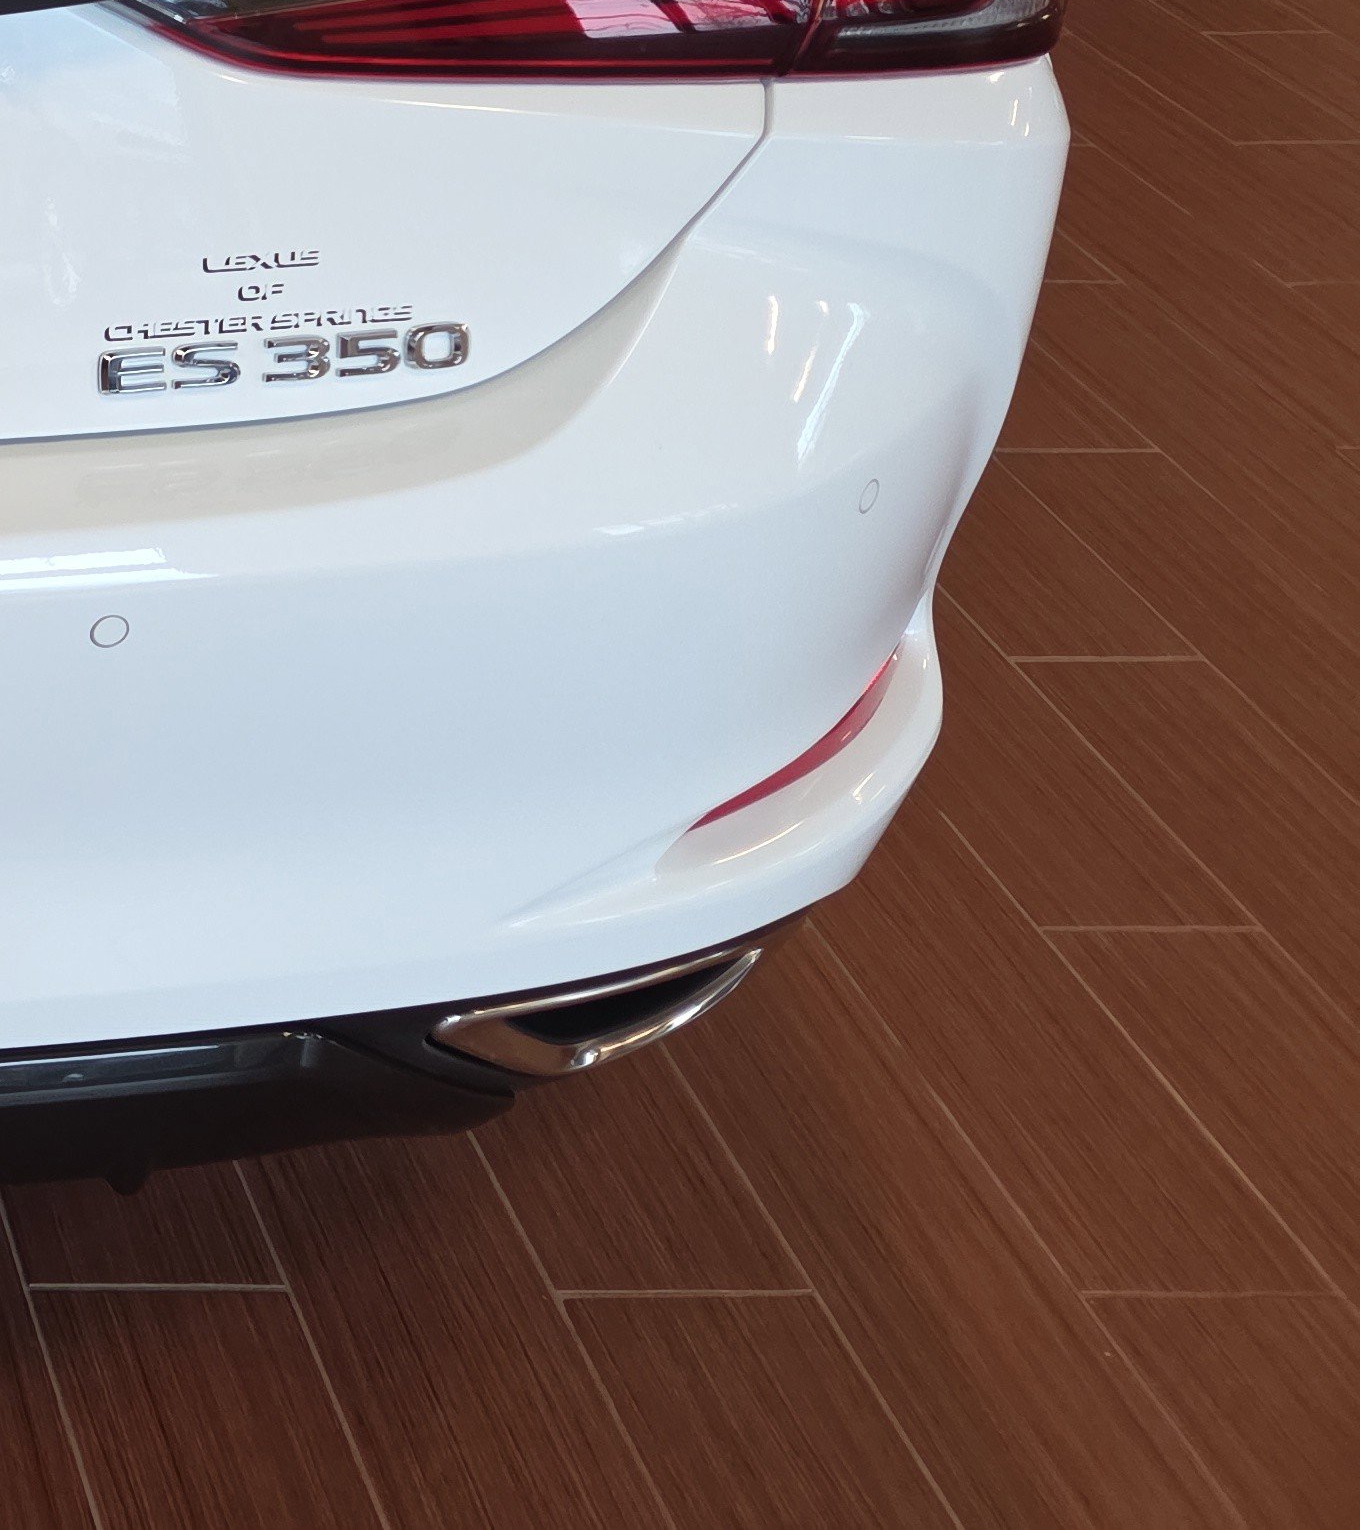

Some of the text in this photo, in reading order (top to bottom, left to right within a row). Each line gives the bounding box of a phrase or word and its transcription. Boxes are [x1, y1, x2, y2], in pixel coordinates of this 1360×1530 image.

[202, 249, 320, 274] LEXUS
[237, 283, 285, 302] OF
[103, 304, 414, 342] CHESTER SPRINGS
[96, 321, 471, 397] ES 350
